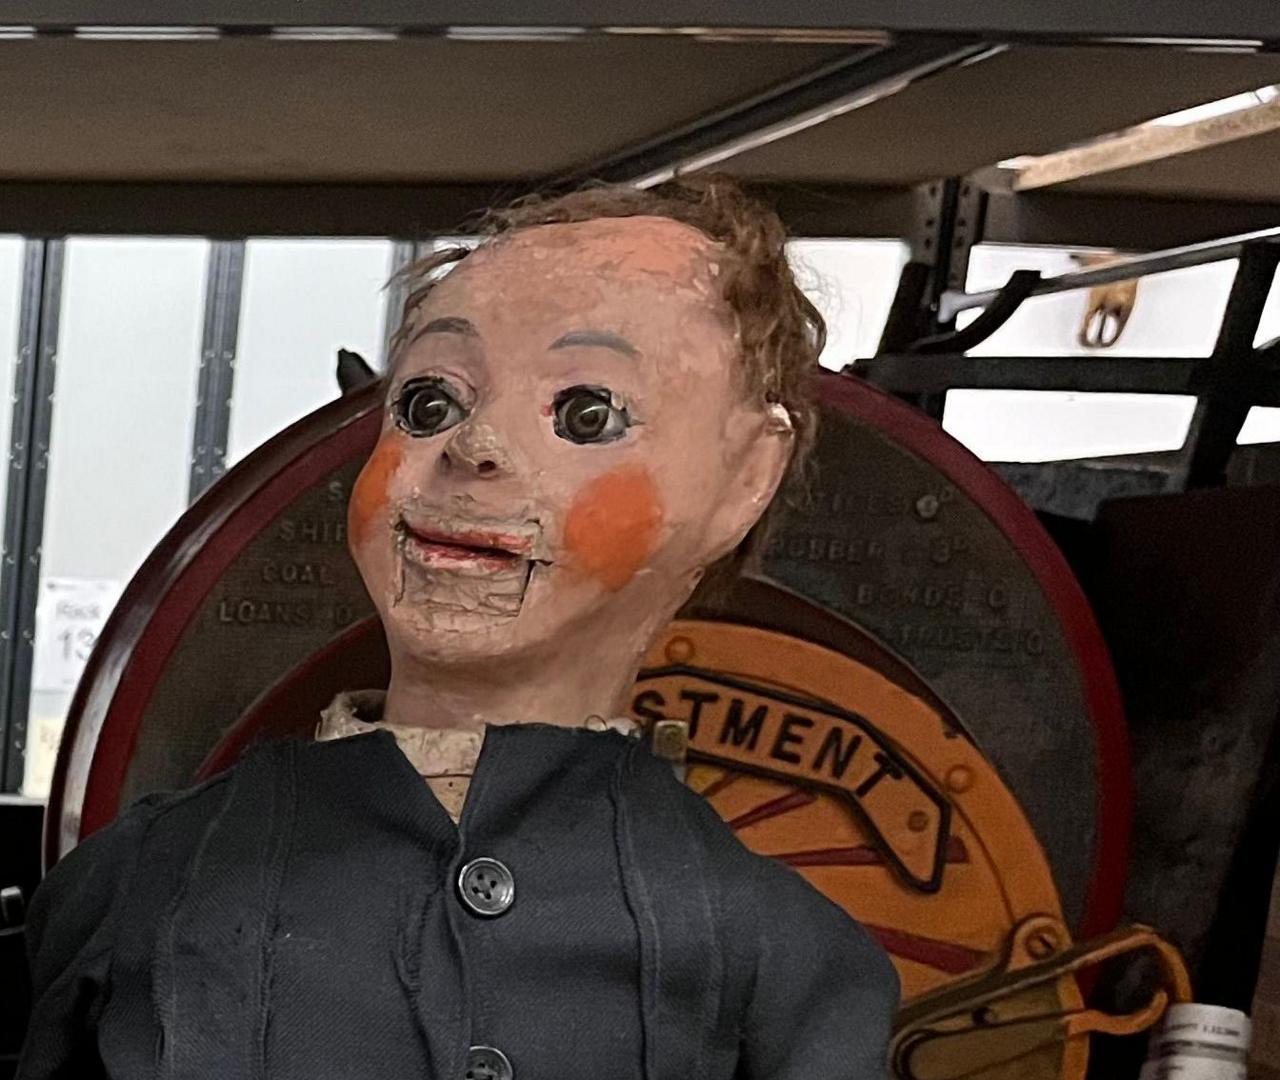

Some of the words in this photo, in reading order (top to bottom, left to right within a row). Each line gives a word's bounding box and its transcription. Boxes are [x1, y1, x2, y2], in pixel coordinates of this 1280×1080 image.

[262, 562, 336, 585] COAL
[219, 601, 313, 624] LOANS
[631, 689, 906, 798] STMENT
